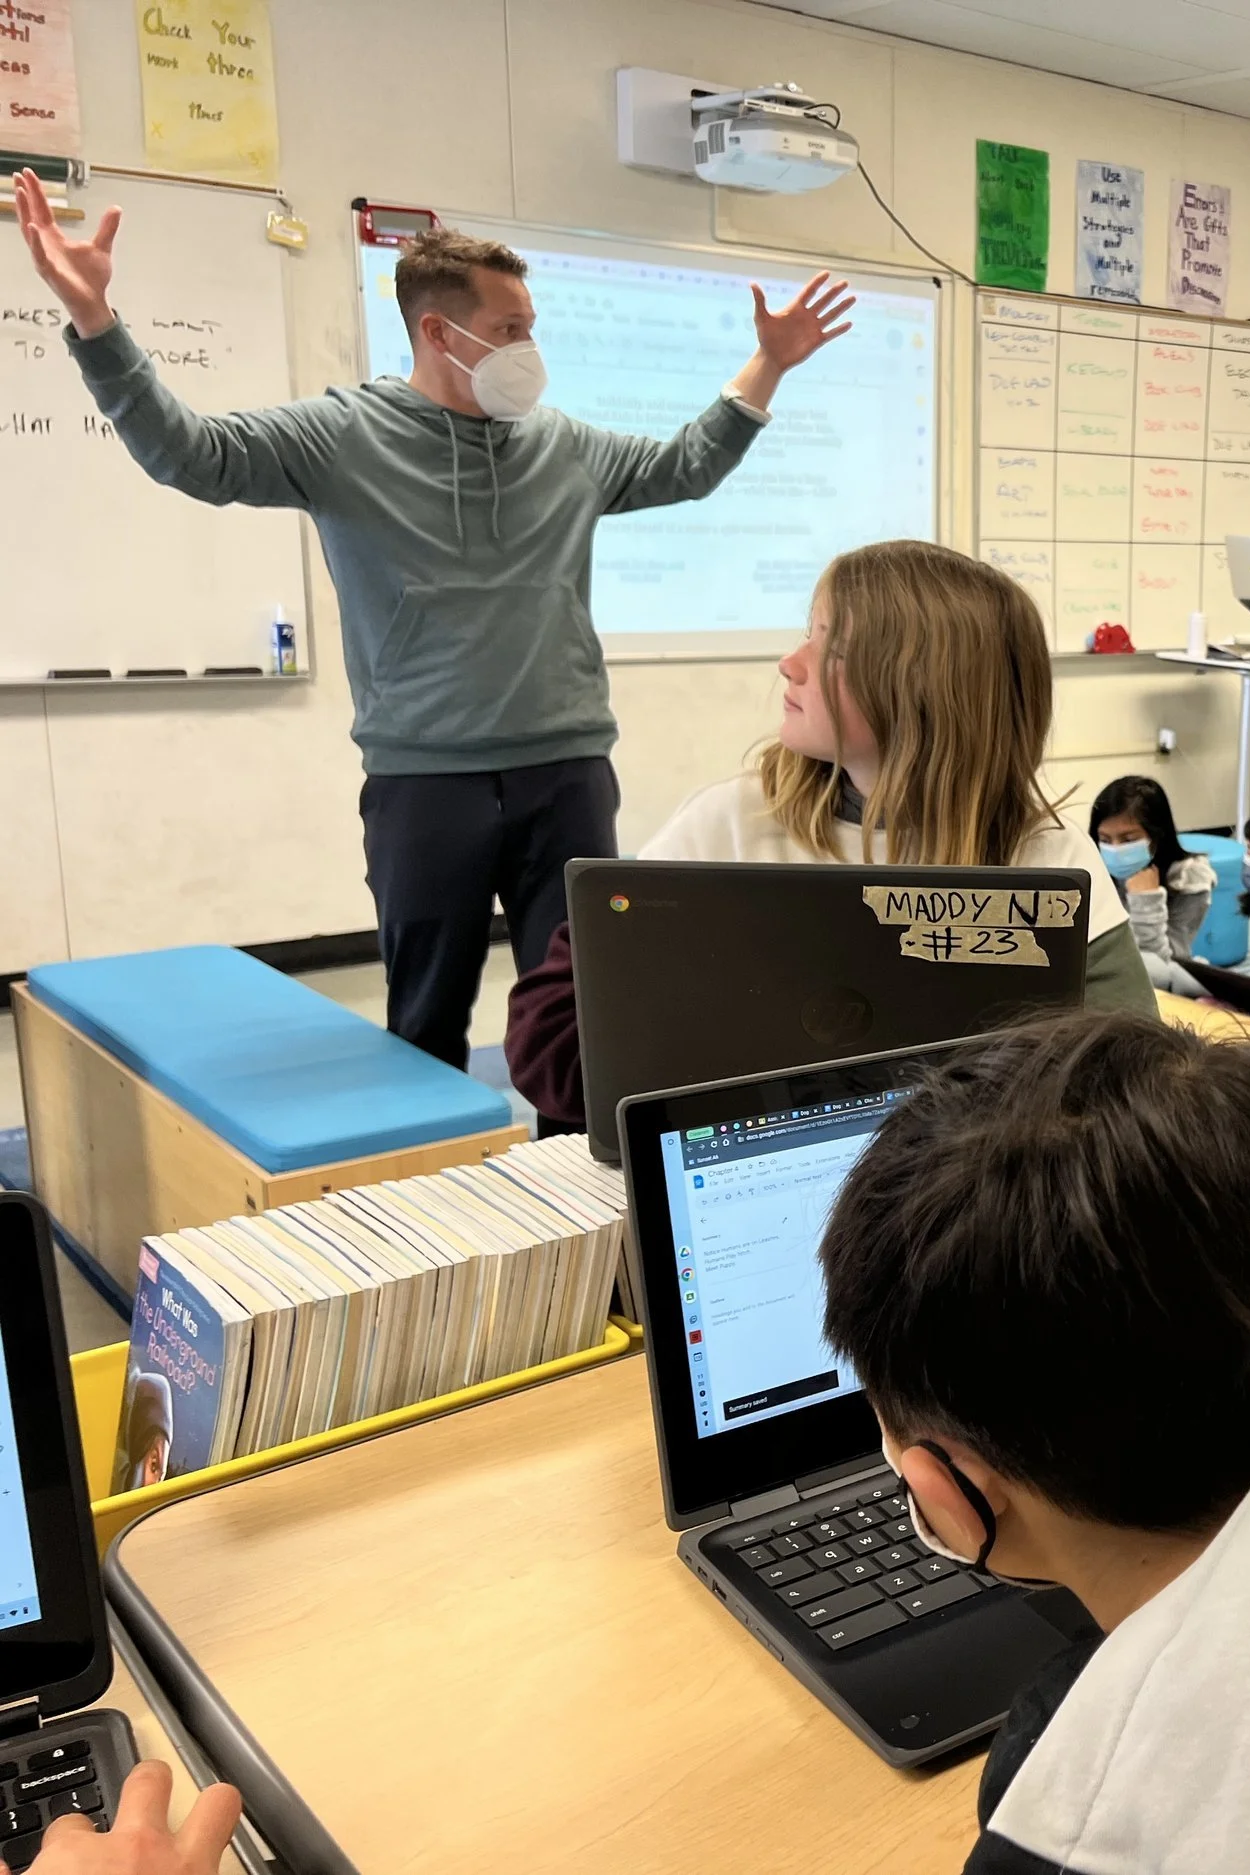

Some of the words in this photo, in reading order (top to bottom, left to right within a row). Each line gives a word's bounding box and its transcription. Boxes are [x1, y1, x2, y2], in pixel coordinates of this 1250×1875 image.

[143, 7, 192, 40] Check
[211, 19, 256, 49] Your
[1101, 166, 1122, 183] Use
[886, 892, 992, 923] MADDY
[708, 1167, 733, 1177] Chapter
[162, 1287, 184, 1319] What
[182, 1309, 199, 1338] Was
[153, 1306, 216, 1386] Underground
[147, 1331, 196, 1395] Railroad?
[729, 1401, 753, 1414] Summary
[753, 1396, 768, 1406] saved
[809, 1608, 827, 1618] shift
[831, 1631, 845, 1640] ctrl
[21, 1766, 87, 1790] backspace
